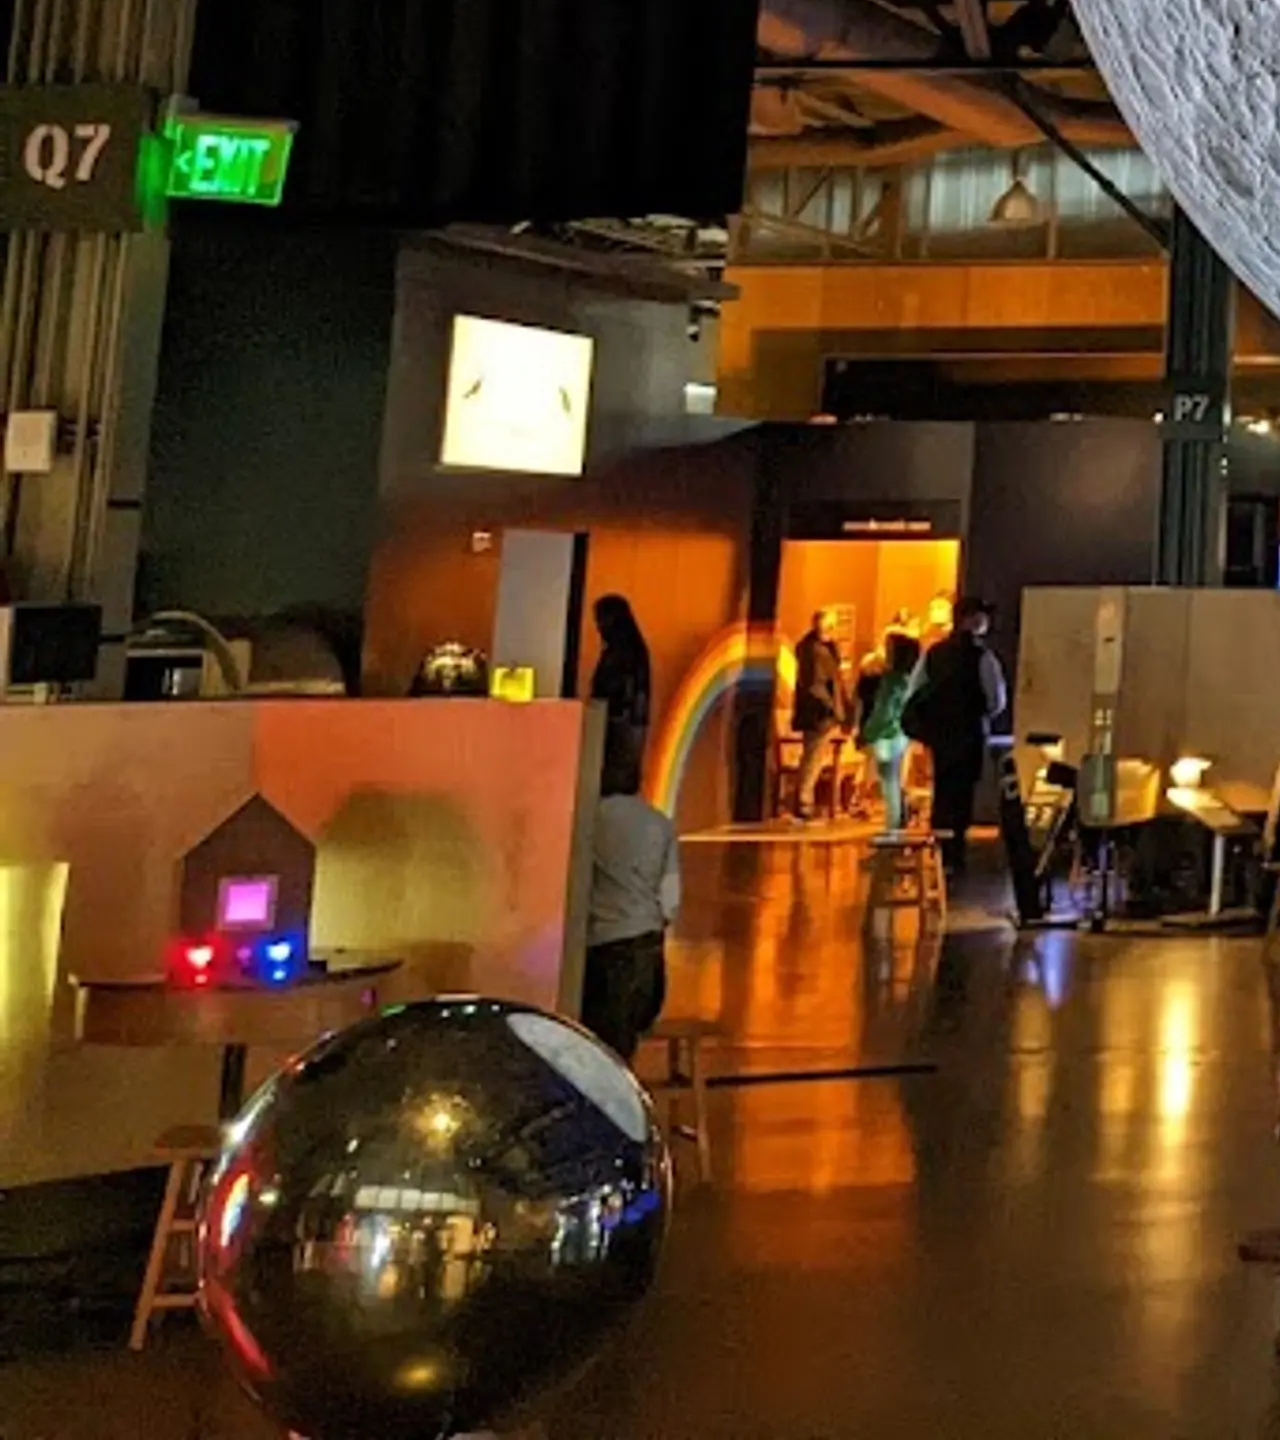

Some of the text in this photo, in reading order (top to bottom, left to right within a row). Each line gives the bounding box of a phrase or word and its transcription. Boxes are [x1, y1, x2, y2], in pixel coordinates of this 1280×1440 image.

[25, 123, 110, 190] Q7
[189, 134, 271, 196] EXIT
[1174, 394, 1210, 422] P7
